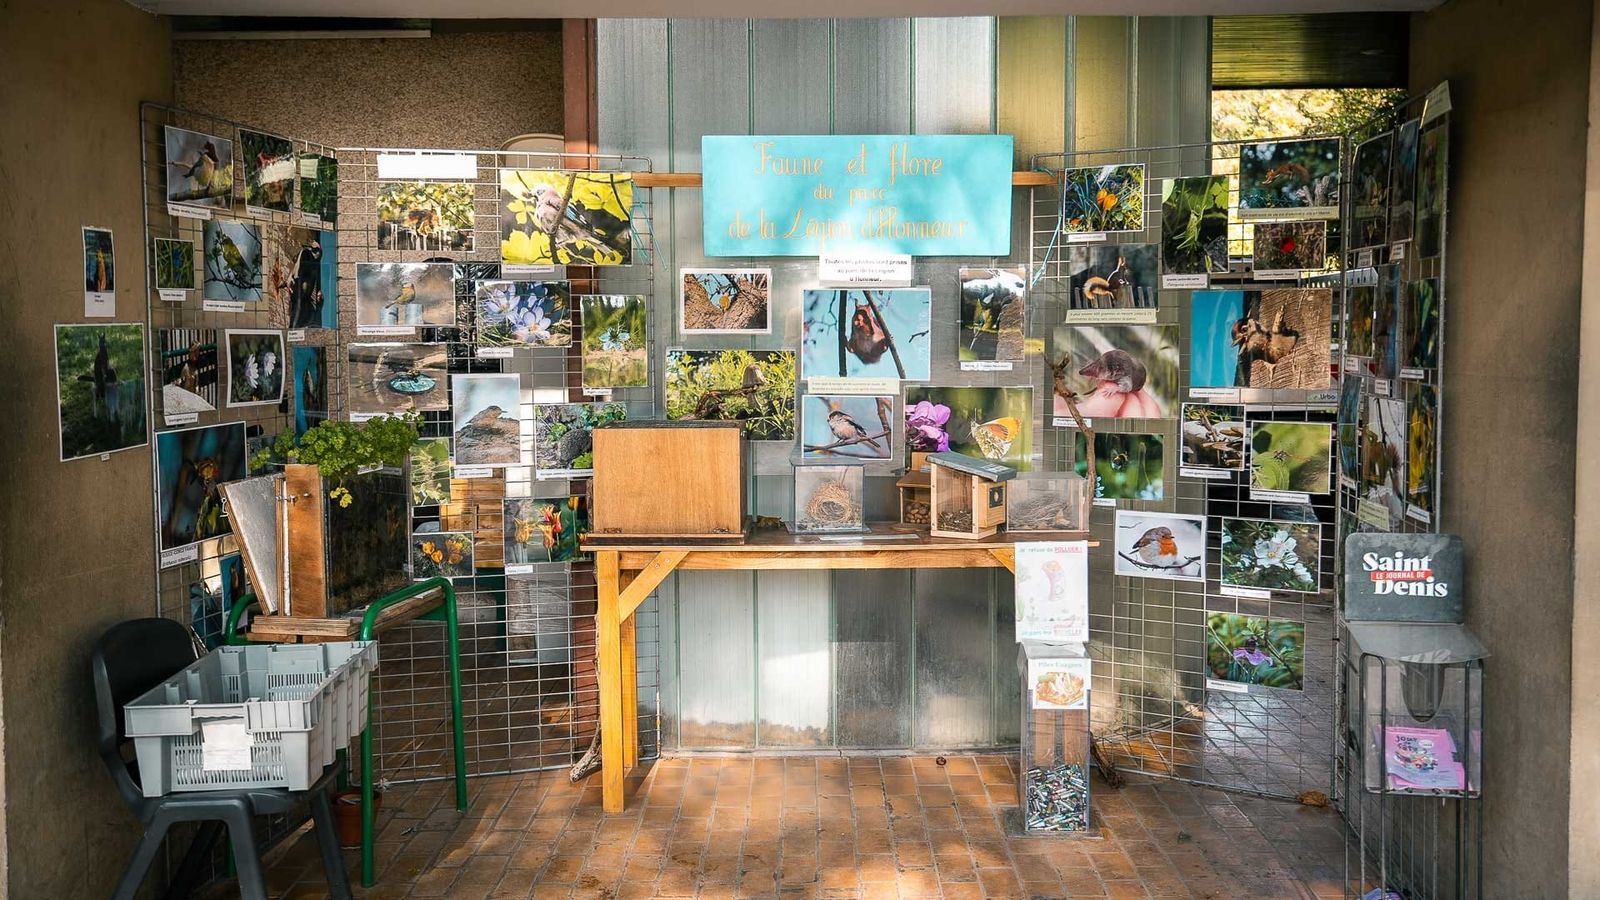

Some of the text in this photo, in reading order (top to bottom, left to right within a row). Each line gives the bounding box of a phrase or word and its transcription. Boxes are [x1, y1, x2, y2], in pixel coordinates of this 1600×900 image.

[754, 141, 943, 185] Faune et flore
[814, 183, 886, 206] du parc
[728, 209, 750, 240] de
[759, 208, 776, 240] la
[1362, 551, 1433, 571] Saint
[1386, 571, 1414, 579] JOURNAL
[1373, 576, 1448, 597] Denis
